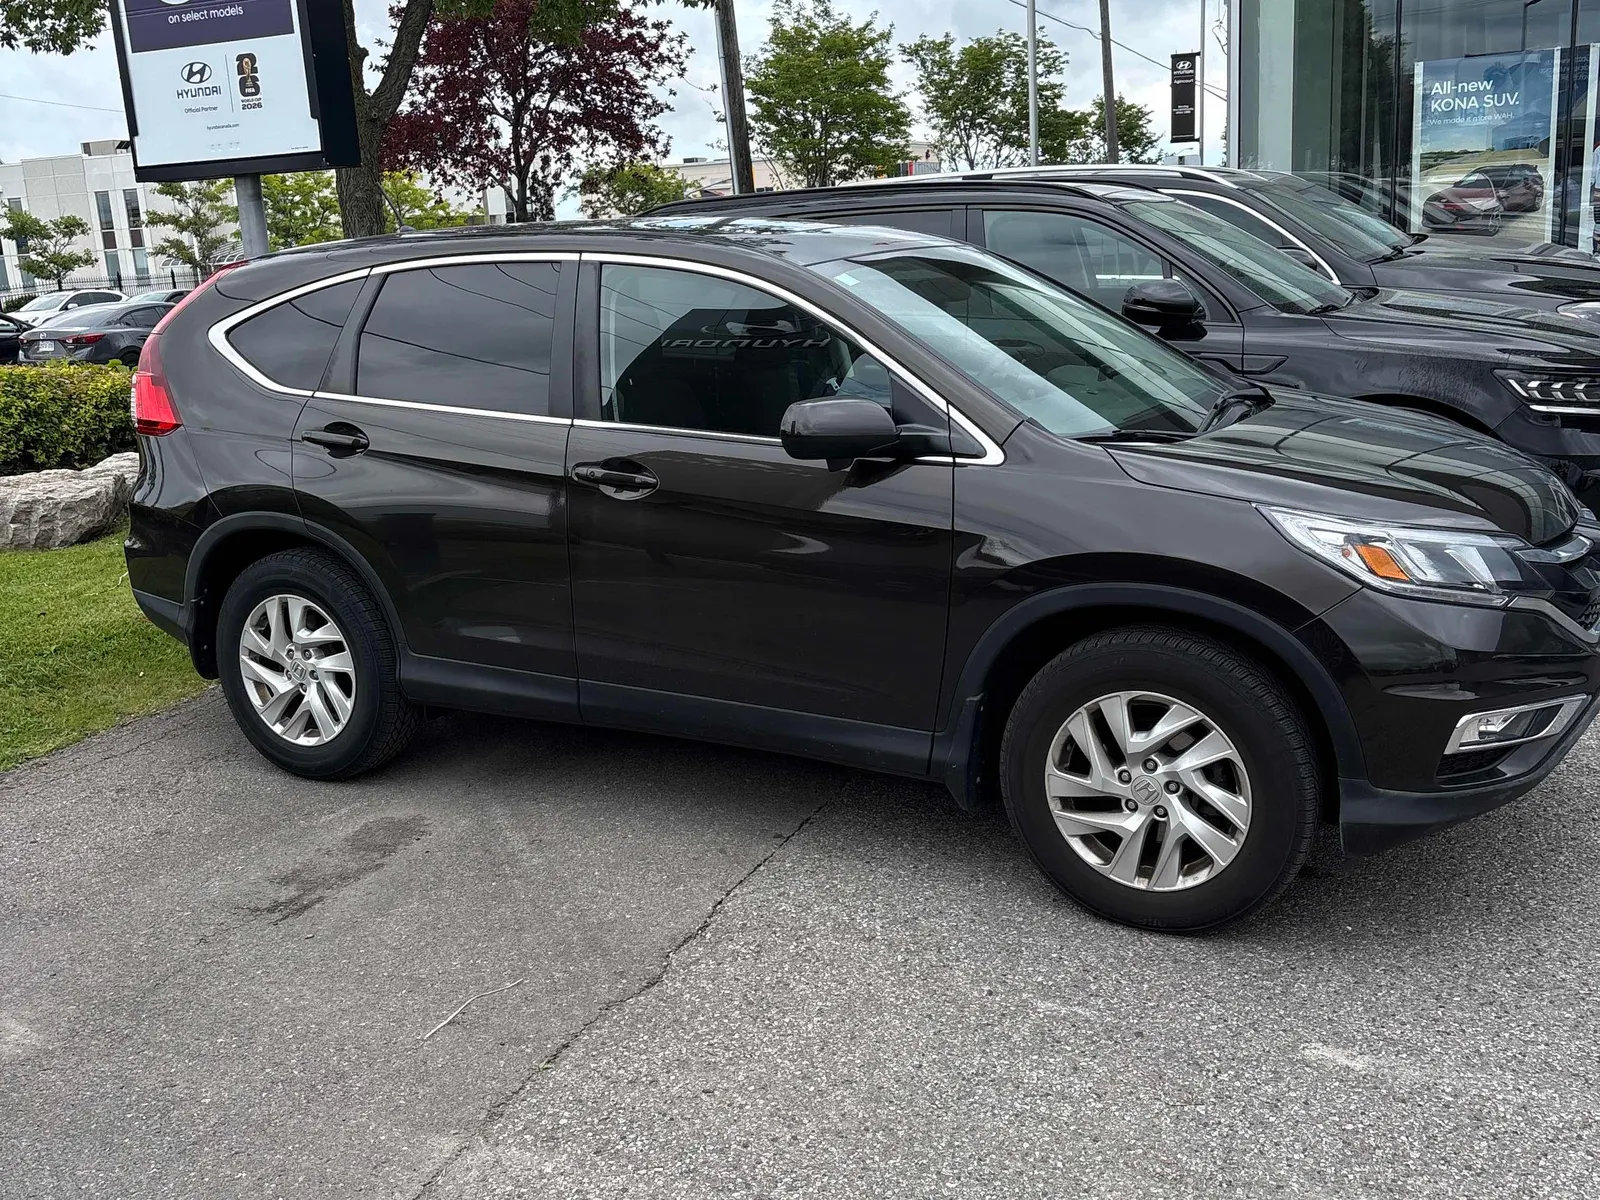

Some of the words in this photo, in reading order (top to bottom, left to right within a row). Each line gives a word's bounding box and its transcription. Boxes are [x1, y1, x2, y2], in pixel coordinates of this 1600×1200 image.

[168, 14, 181, 24] on
[181, 9, 209, 22] select
[209, 4, 244, 19] models
[176, 85, 222, 99] HYUNDAI
[1430, 80, 1494, 96] All-new
[241, 102, 263, 110] 2026
[1431, 96, 1479, 112] KONA
[1483, 92, 1520, 107] SUV.
[1443, 116, 1465, 124] made
[1493, 112, 1515, 120] WAH.
